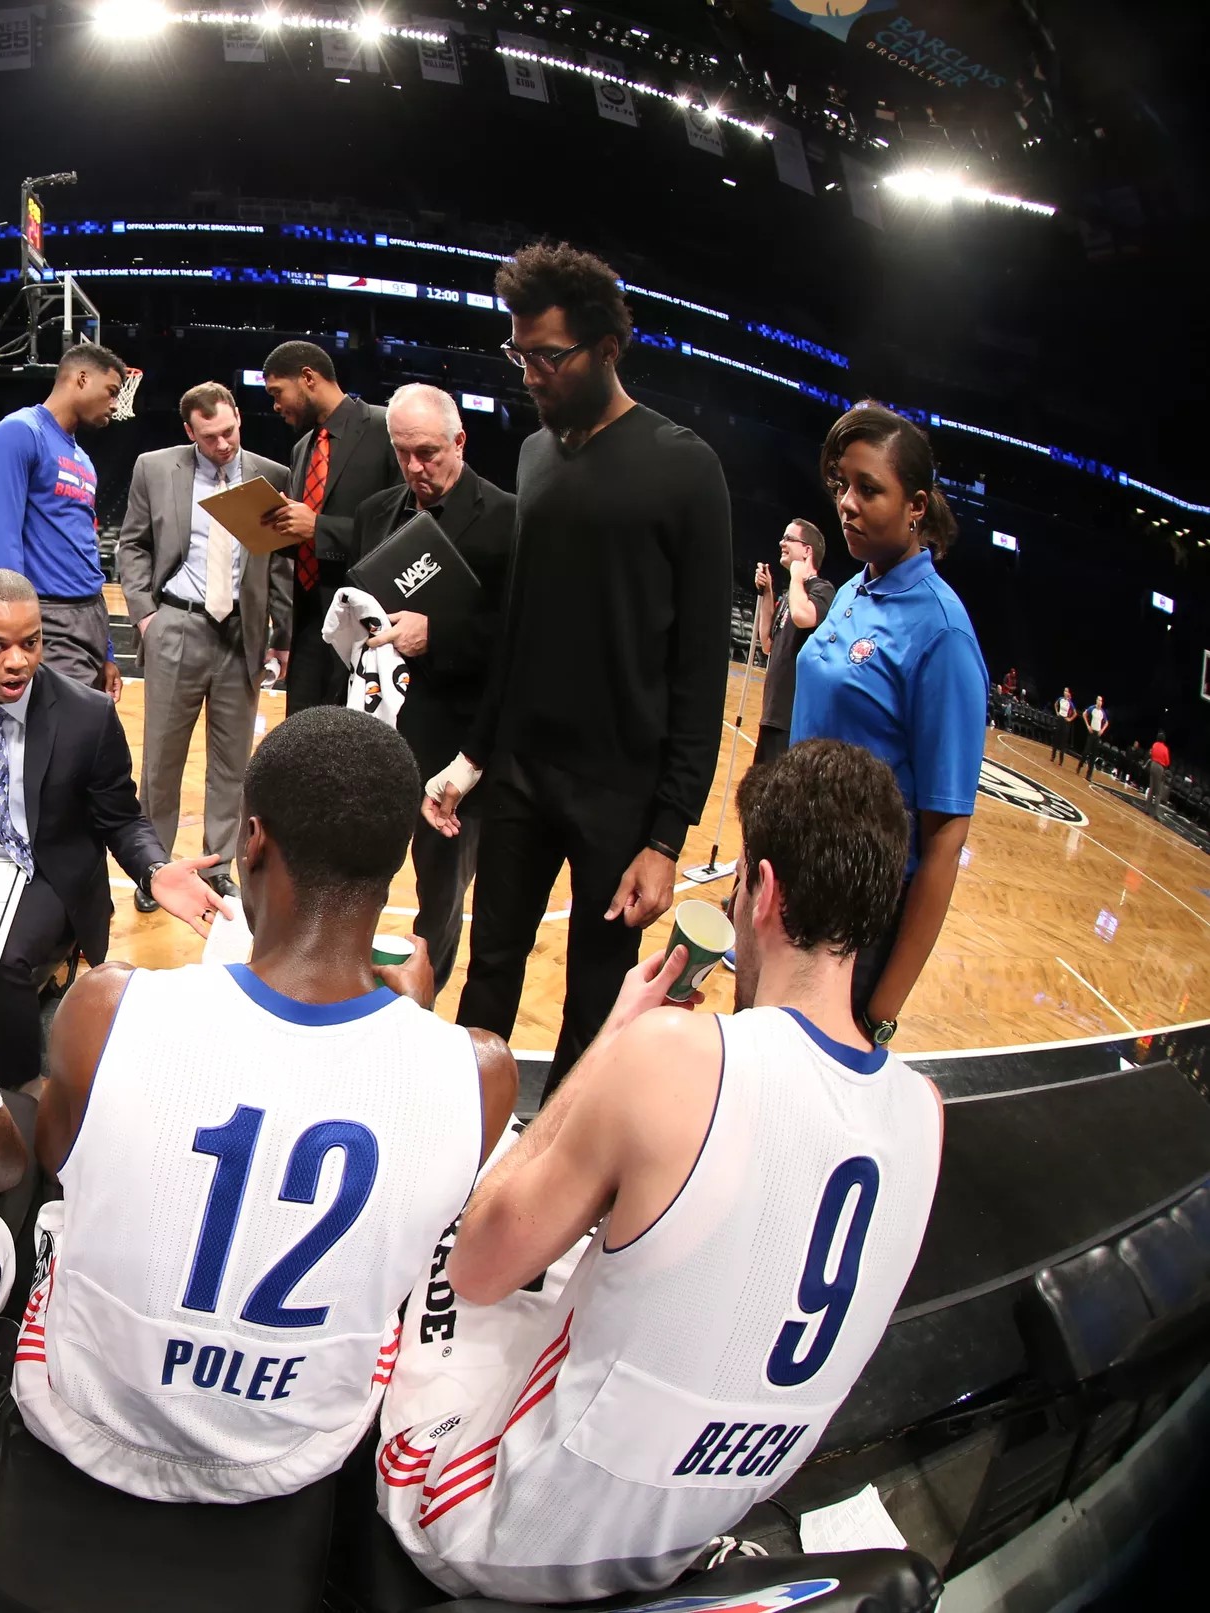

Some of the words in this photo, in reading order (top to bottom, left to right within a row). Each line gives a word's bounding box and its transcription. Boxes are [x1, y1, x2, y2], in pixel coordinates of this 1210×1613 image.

[865, 41, 946, 87] BROOKLYN
[874, 30, 969, 89] CENTER
[888, 15, 1007, 89] BARCLAYS
[126, 223, 155, 231] OFFICIAL
[155, 223, 188, 231] HOSPITAL
[187, 223, 197, 231] OF
[210, 224, 247, 233] BROOKLYN
[246, 225, 265, 233] NETS
[389, 237, 417, 248] OFFICIAL
[417, 242, 447, 253] HOSPITAL
[456, 248, 469, 256] THE
[469, 249, 501, 261] BROOKLYN
[55, 269, 78, 277] WHERE
[78, 269, 92, 277] THE
[91, 269, 109, 277] NETS
[109, 269, 129, 277] COME
[129, 269, 139, 277] TO
[138, 269, 153, 277] GET
[152, 269, 172, 277] BACK
[171, 269, 180, 277] IN
[180, 269, 194, 277] THE
[193, 270, 213, 278] GAME
[391, 283, 408, 295] 95
[426, 286, 460, 303] 12:00
[393, 553, 439, 595] NABC
[180, 1103, 379, 1328] 12
[766, 1154, 880, 1387] 9
[160, 1338, 307, 1402] POLEE
[671, 1421, 809, 1477] BEECH
